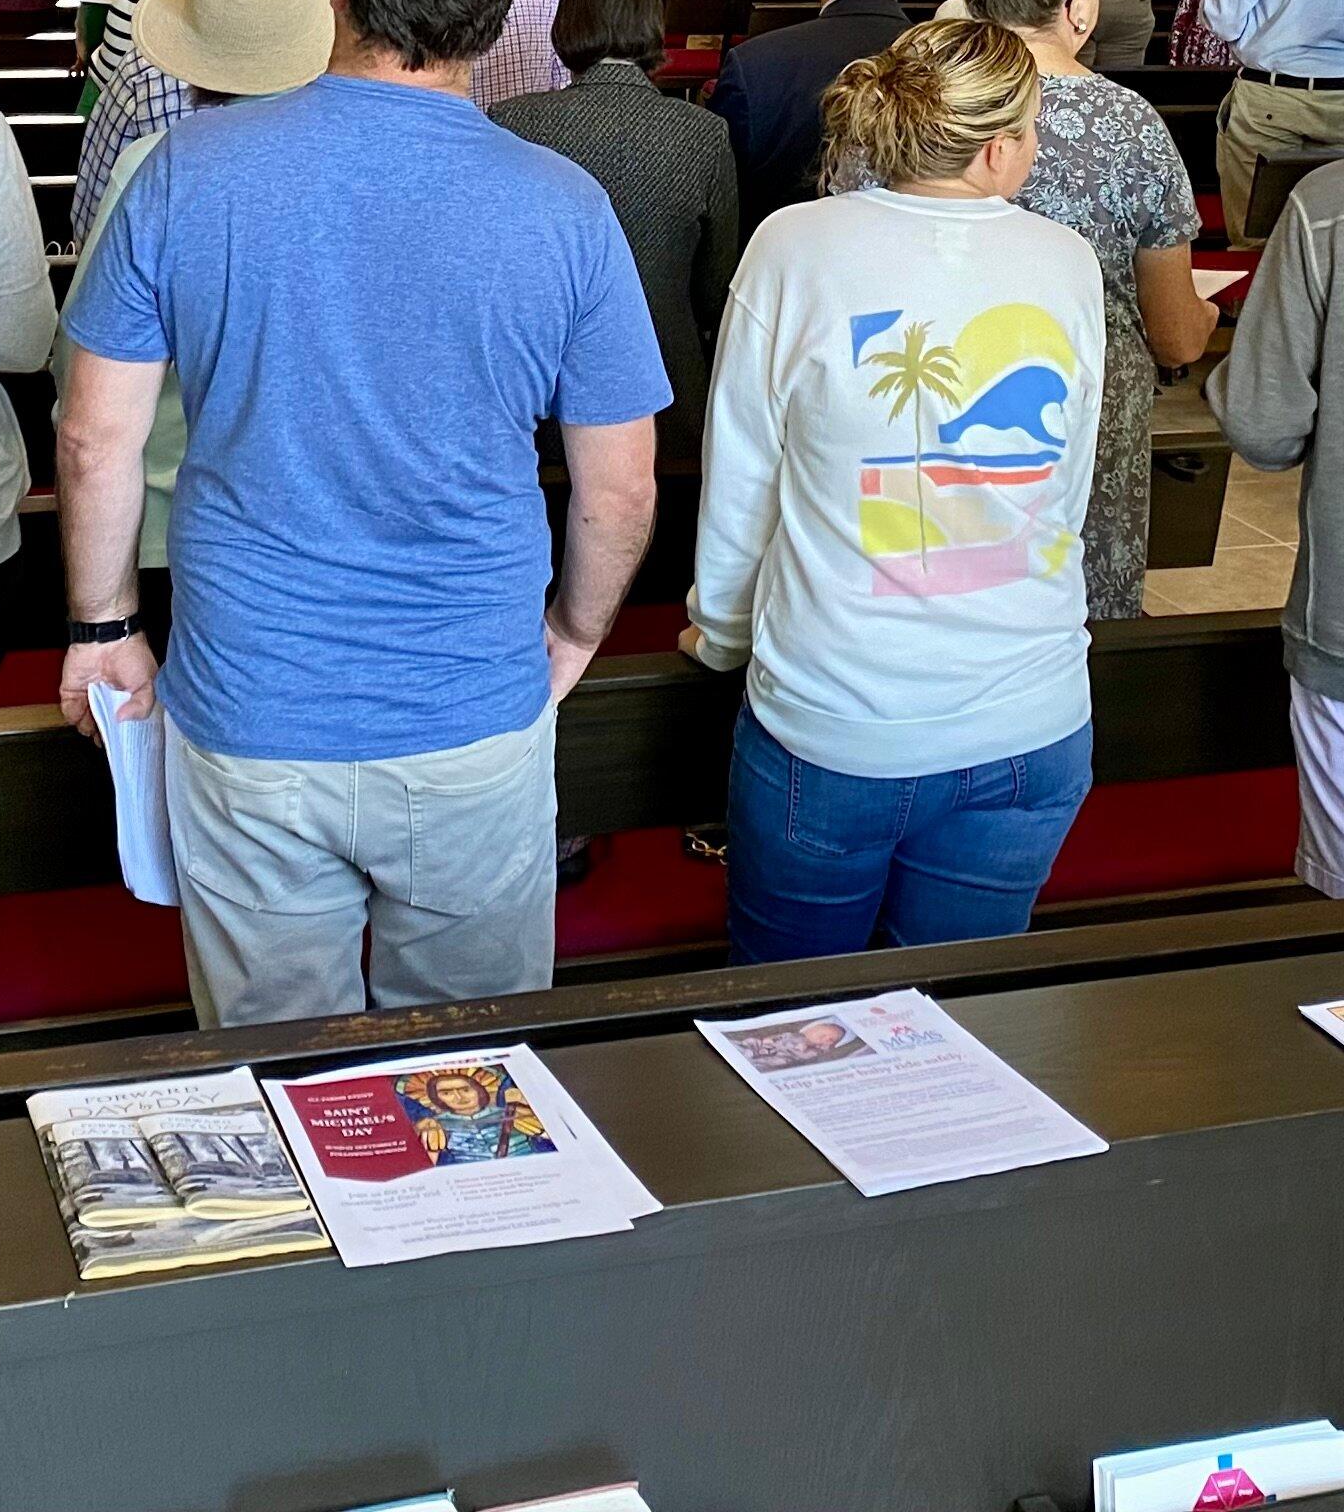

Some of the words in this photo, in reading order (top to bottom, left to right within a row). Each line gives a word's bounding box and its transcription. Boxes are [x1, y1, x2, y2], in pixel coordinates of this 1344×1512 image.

[878, 1031, 943, 1050] MOMS
[85, 1086, 199, 1105] FORWARD
[68, 1102, 137, 1118] DAY
[139, 1101, 153, 1112] by
[156, 1092, 221, 1109] DAY
[323, 1106, 371, 1118] SAINT
[309, 1114, 396, 1128] MICHAEL'S
[341, 1127, 373, 1137] DAY
